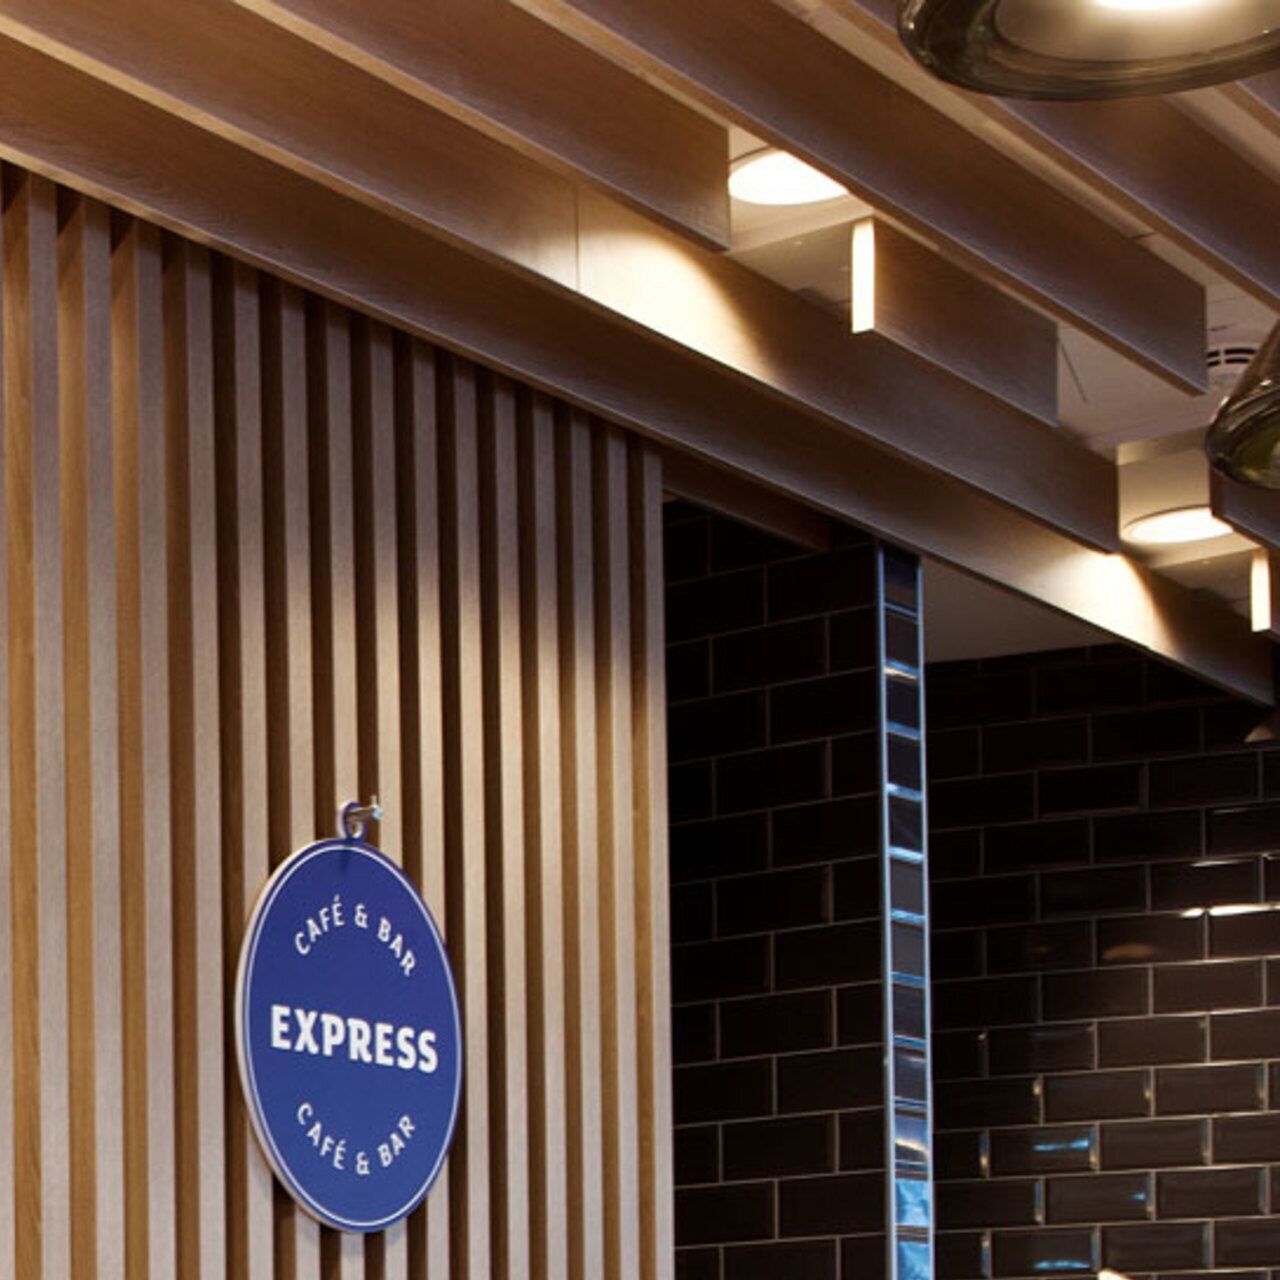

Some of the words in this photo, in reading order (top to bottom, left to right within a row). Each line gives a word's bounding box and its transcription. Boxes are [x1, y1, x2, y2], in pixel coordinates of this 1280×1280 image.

[295, 895, 344, 955] CAFÉ
[354, 903, 368, 928] &
[378, 917, 415, 976] BAR
[271, 1004, 438, 1074] EXPRESS
[297, 1102, 346, 1170] CAFÉ
[356, 1152, 370, 1175] &
[378, 1115, 415, 1167] BAR
